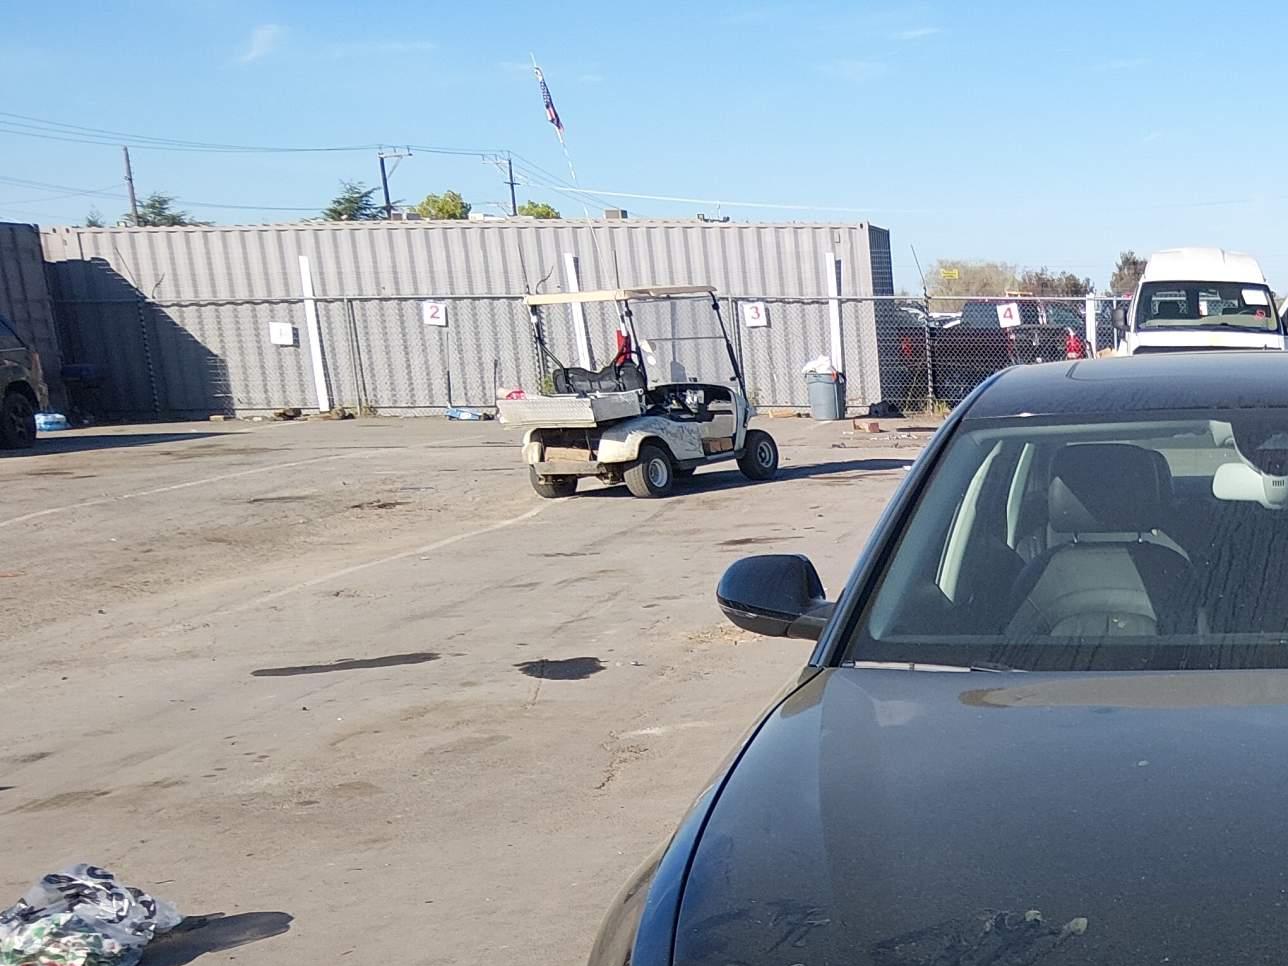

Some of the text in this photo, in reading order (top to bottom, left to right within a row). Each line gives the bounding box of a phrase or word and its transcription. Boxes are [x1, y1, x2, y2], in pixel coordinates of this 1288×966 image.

[430, 304, 441, 319] 2
[750, 305, 760, 320] 3
[1003, 307, 1013, 320] 4
